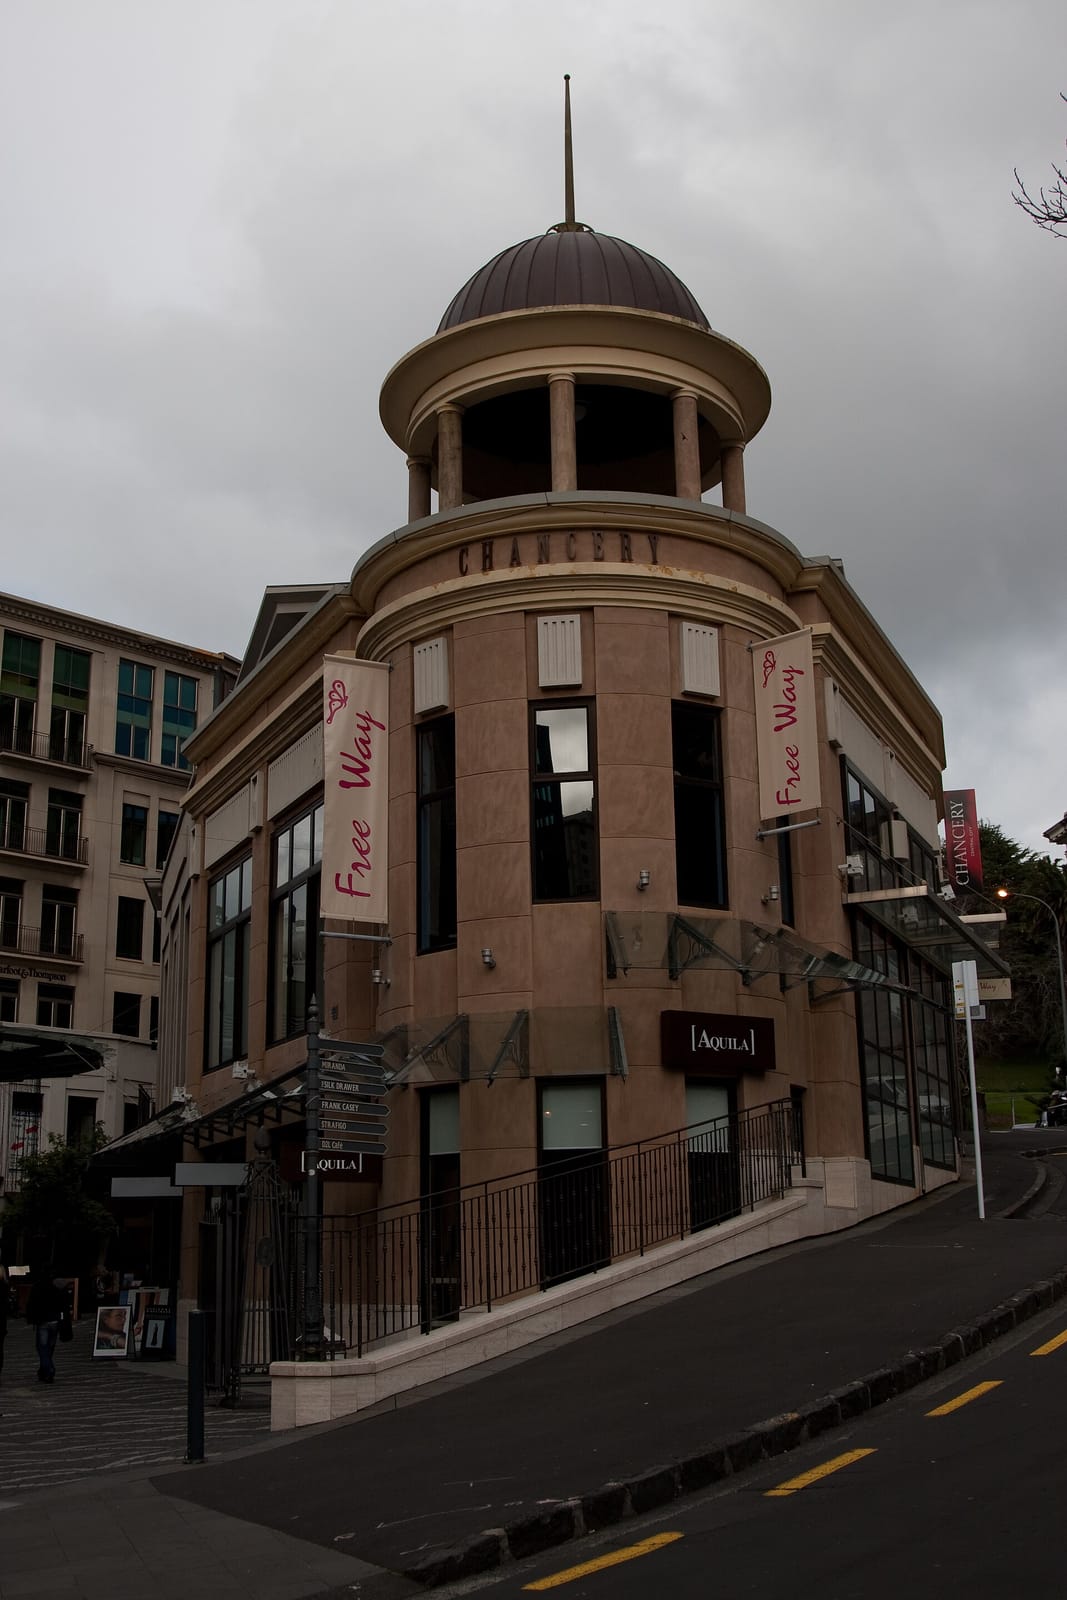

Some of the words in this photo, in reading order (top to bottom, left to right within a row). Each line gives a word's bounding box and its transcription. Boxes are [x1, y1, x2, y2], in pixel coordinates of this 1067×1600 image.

[459, 529, 659, 576] CHANCERY
[773, 665, 804, 732] Way
[339, 711, 386, 789] Way
[776, 744, 802, 805] Free
[335, 820, 371, 897] Free
[950, 800, 970, 886] CHANCERY
[321, 1101, 341, 1110] FRANK
[342, 1103, 360, 1112] CASEY
